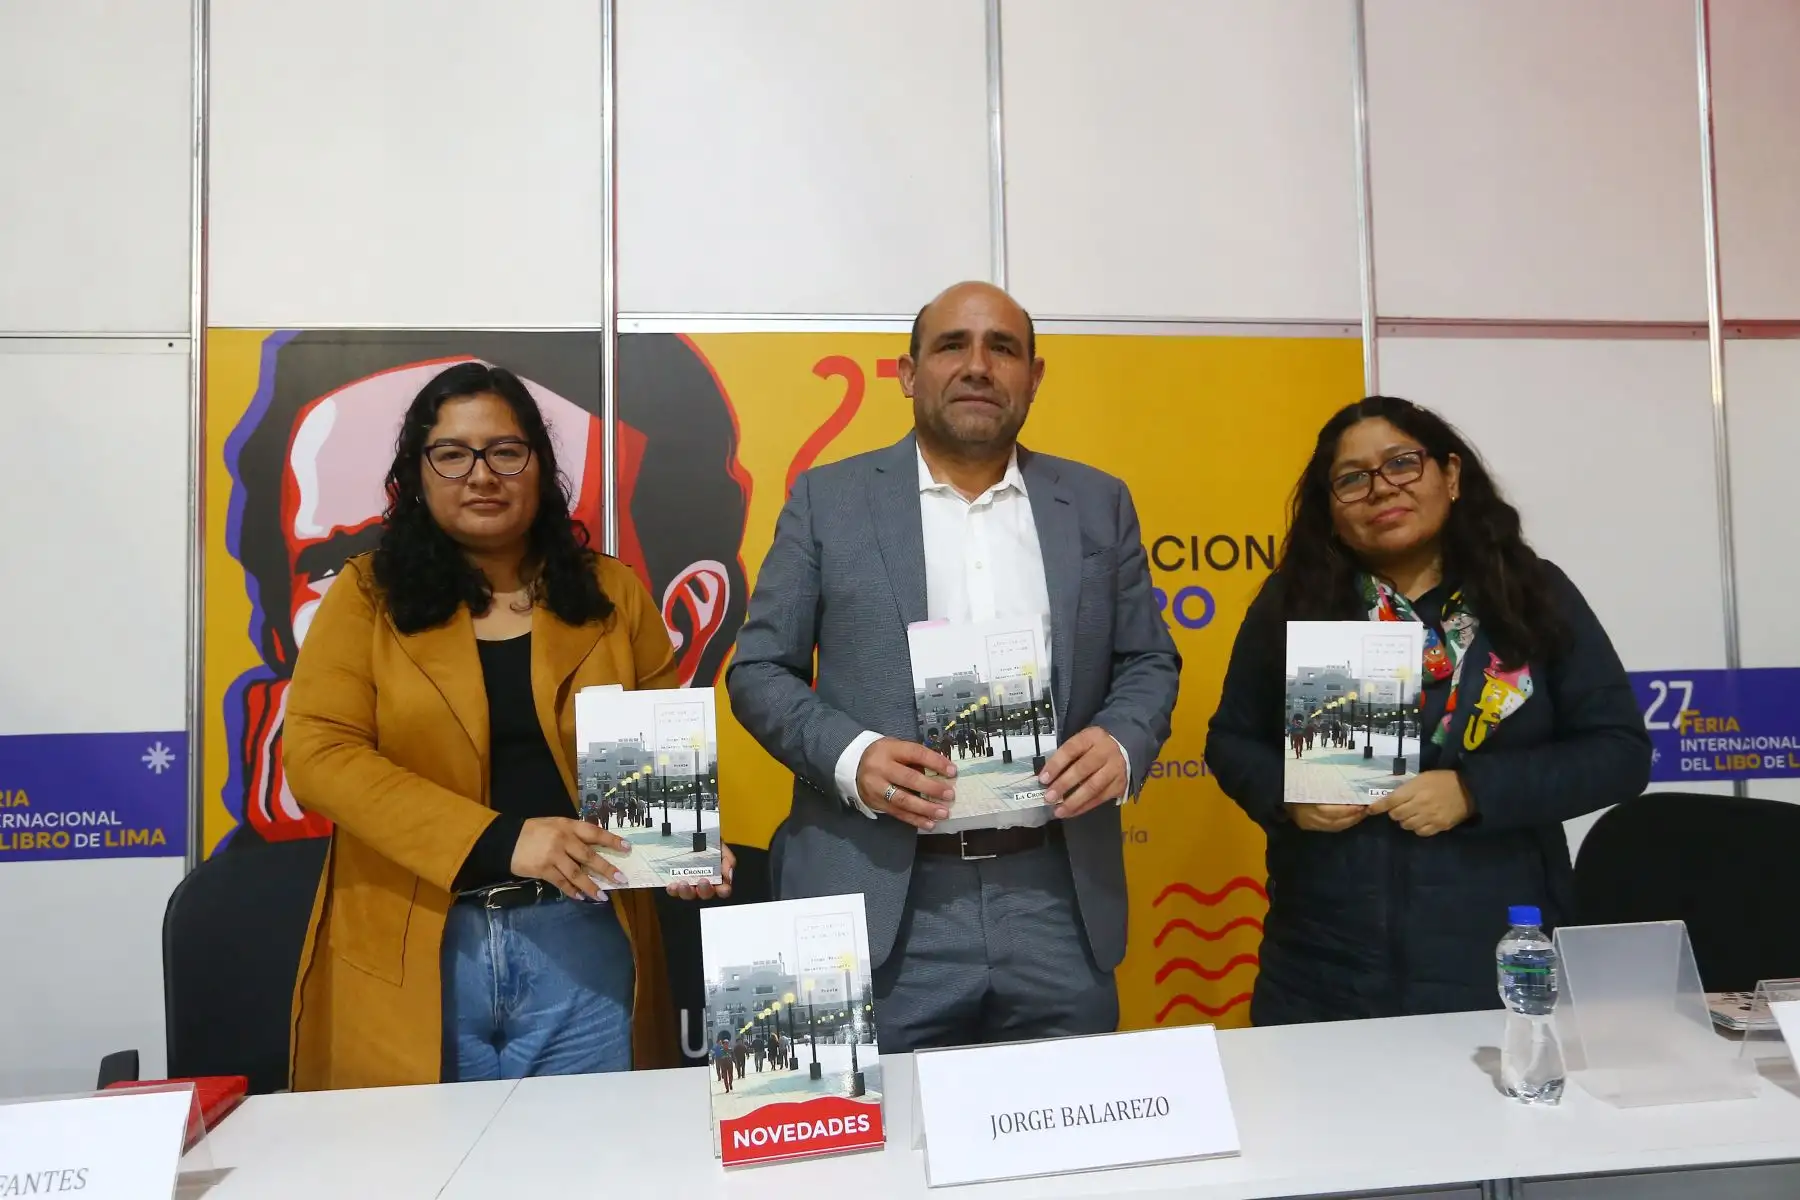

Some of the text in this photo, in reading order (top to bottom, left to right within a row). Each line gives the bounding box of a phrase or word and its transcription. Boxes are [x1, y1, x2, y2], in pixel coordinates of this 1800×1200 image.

[1643, 680, 1694, 730] 27
[1680, 709, 1741, 736] FERIA
[1681, 757, 1712, 772] DEL
[1764, 755, 1786, 769] DE
[0, 810, 122, 829] RNACIONAL
[74, 832, 101, 849] DE
[105, 828, 167, 848] LIMA
[733, 1113, 870, 1149] NOVEDADES
[990, 1095, 1170, 1141] JORGE BALAREZO
